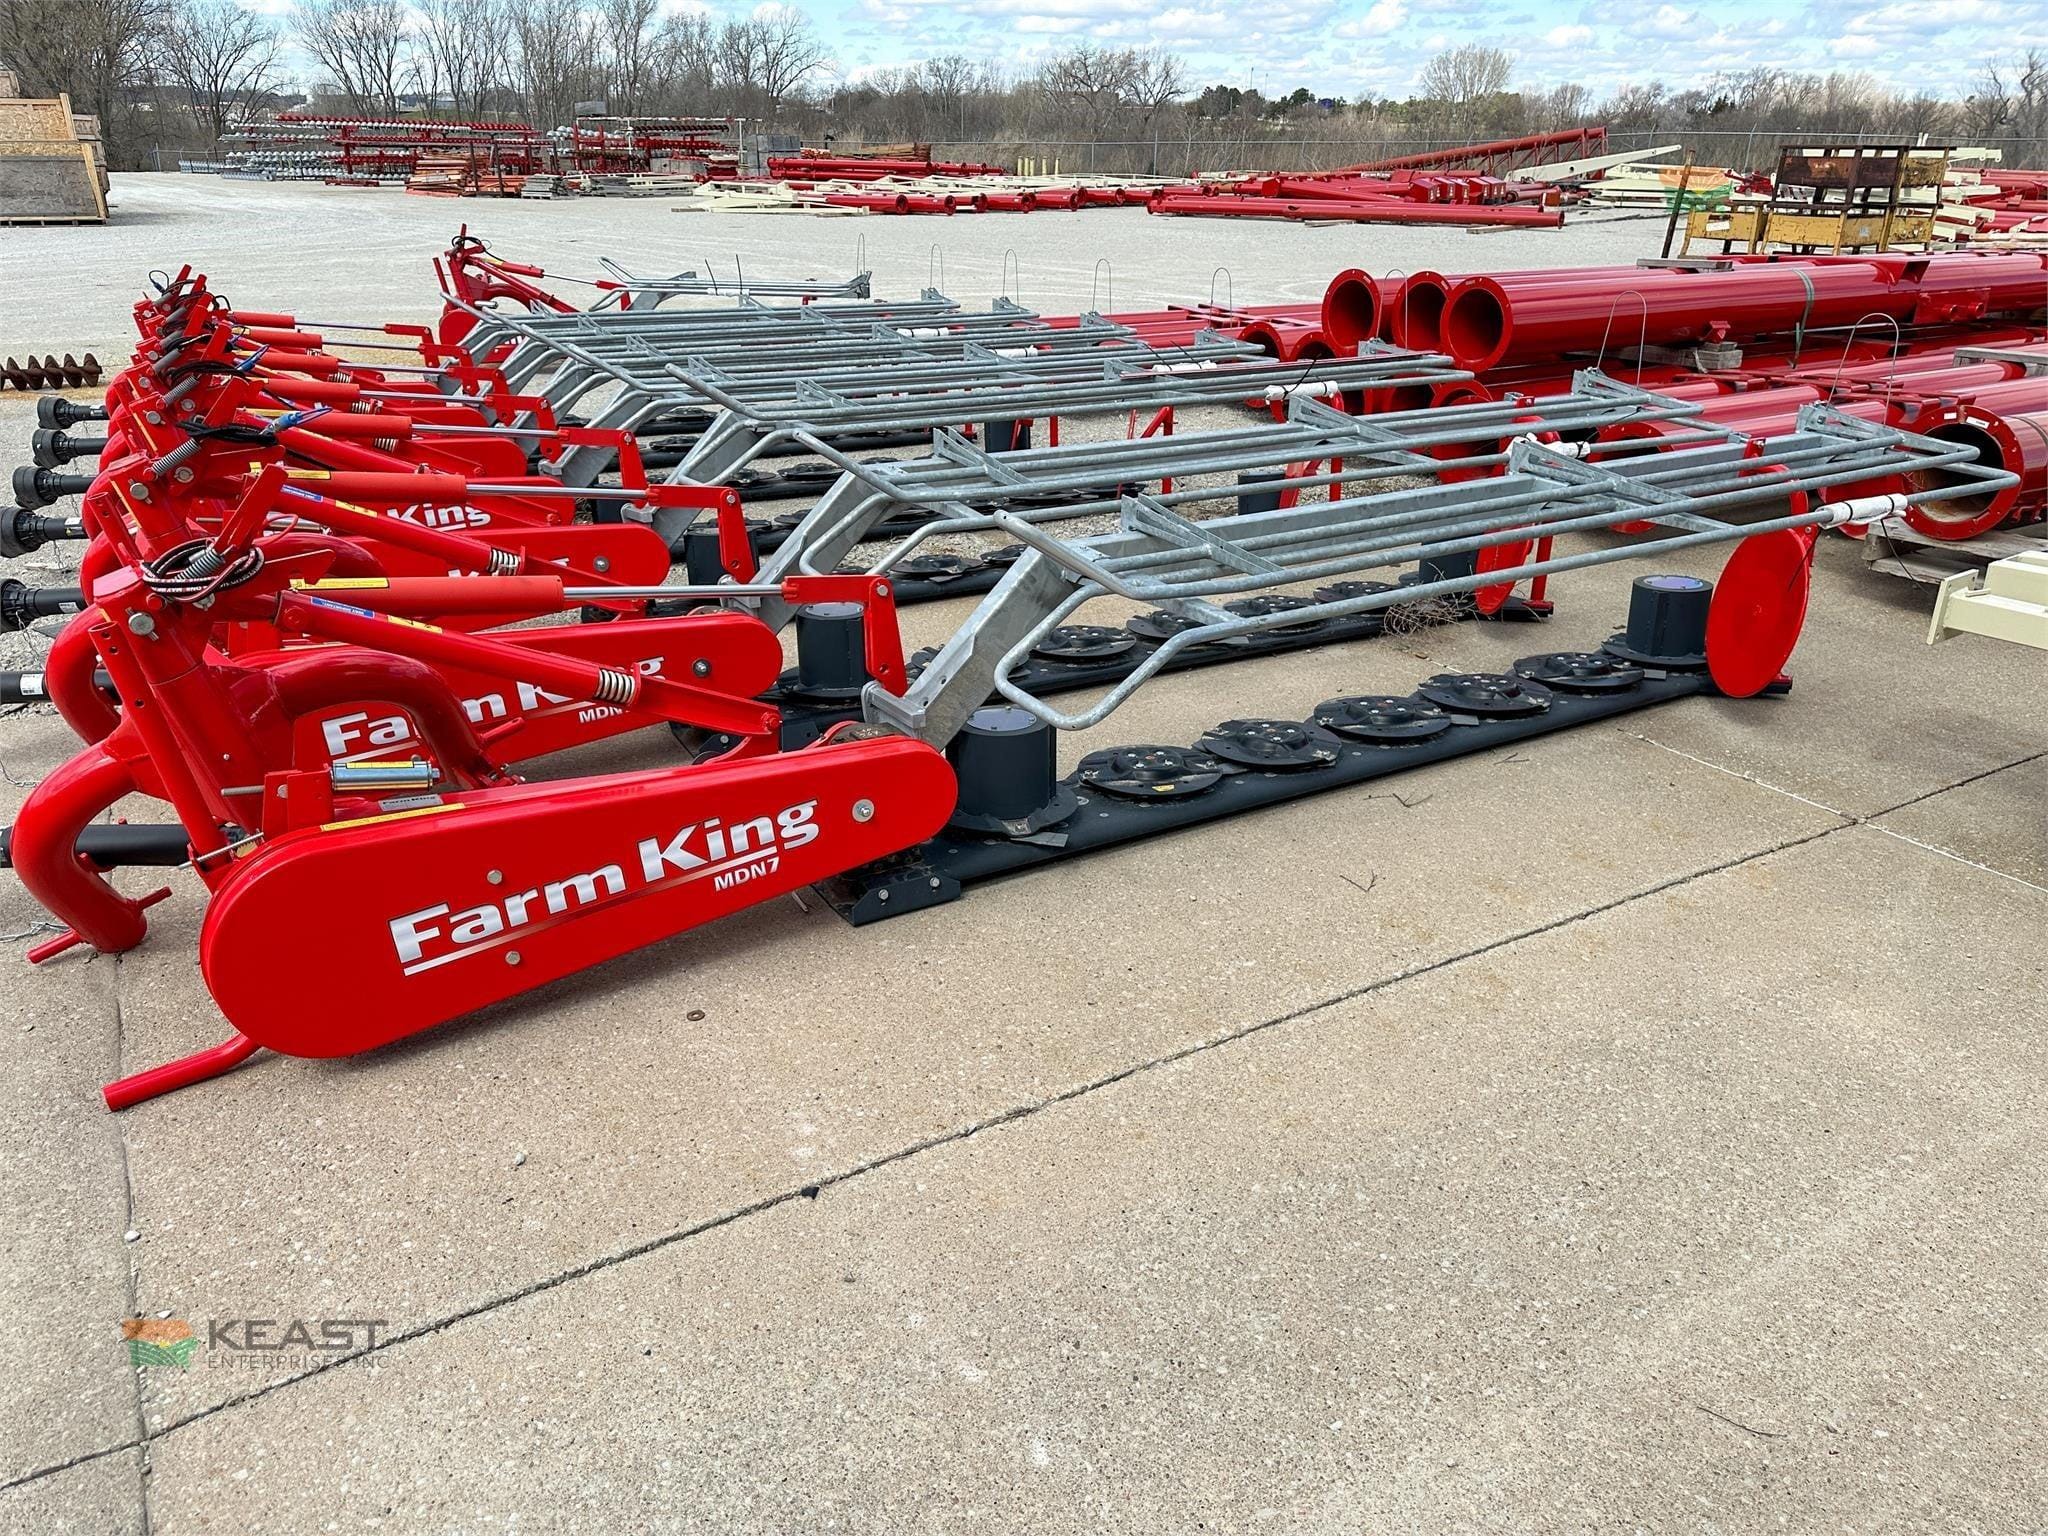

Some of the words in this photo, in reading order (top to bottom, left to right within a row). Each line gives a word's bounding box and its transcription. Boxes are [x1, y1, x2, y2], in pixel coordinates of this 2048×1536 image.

[389, 863, 627, 964] Farm
[637, 799, 820, 883] King
[713, 856, 780, 892] MDN7
